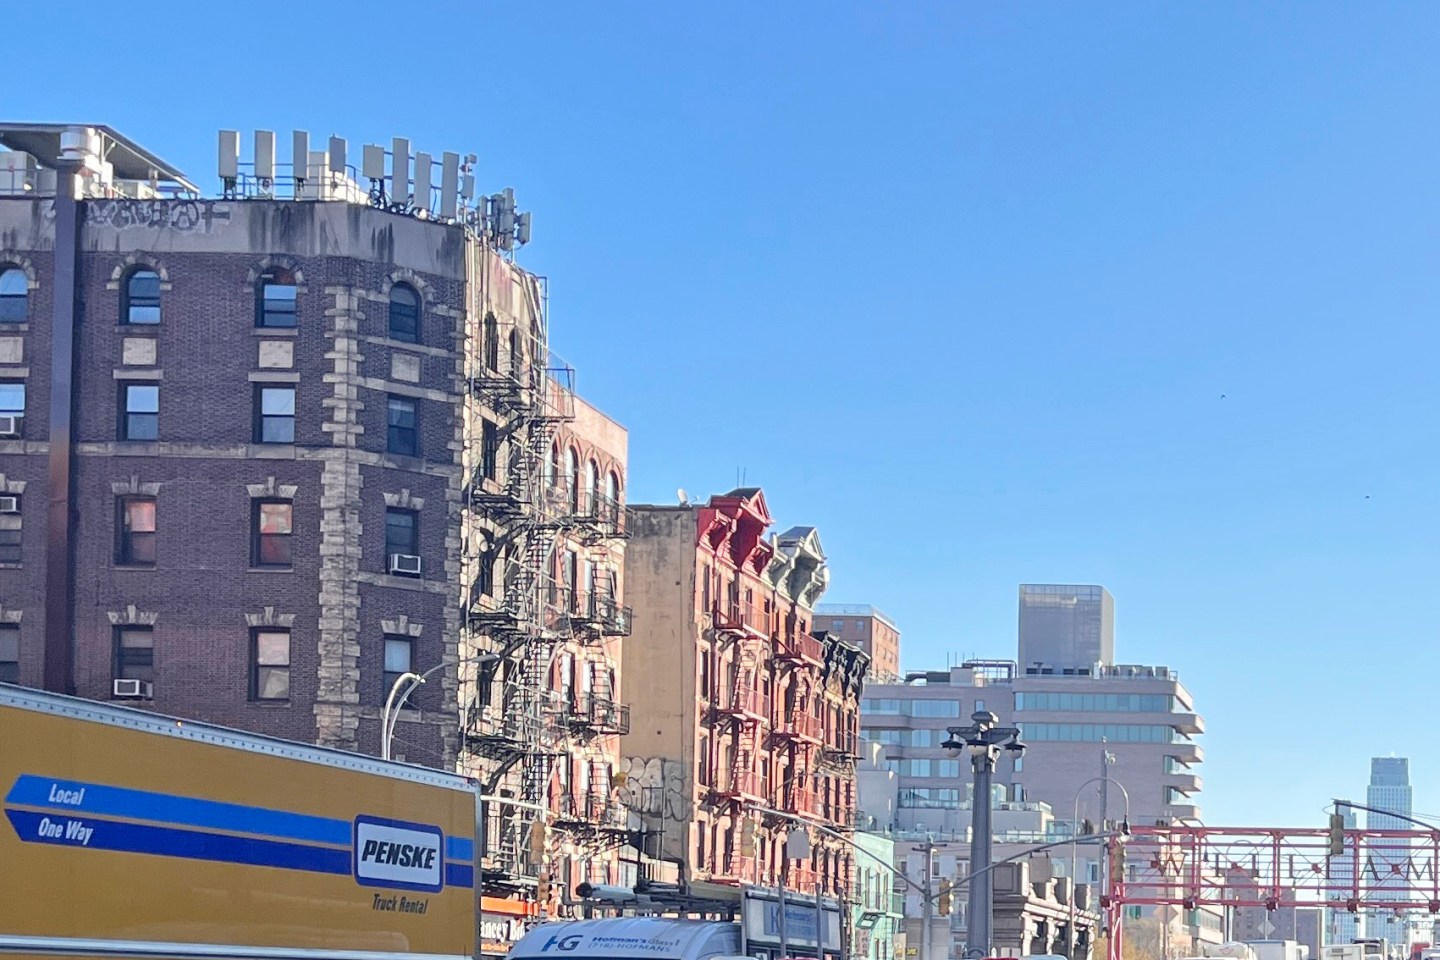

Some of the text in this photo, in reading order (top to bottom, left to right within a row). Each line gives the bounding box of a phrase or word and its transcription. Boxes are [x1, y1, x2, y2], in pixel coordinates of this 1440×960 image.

[49, 783, 85, 806] Local
[38, 817, 94, 846] One Way
[361, 839, 437, 869] PENSKE
[372, 893, 429, 915] Truck Rental
